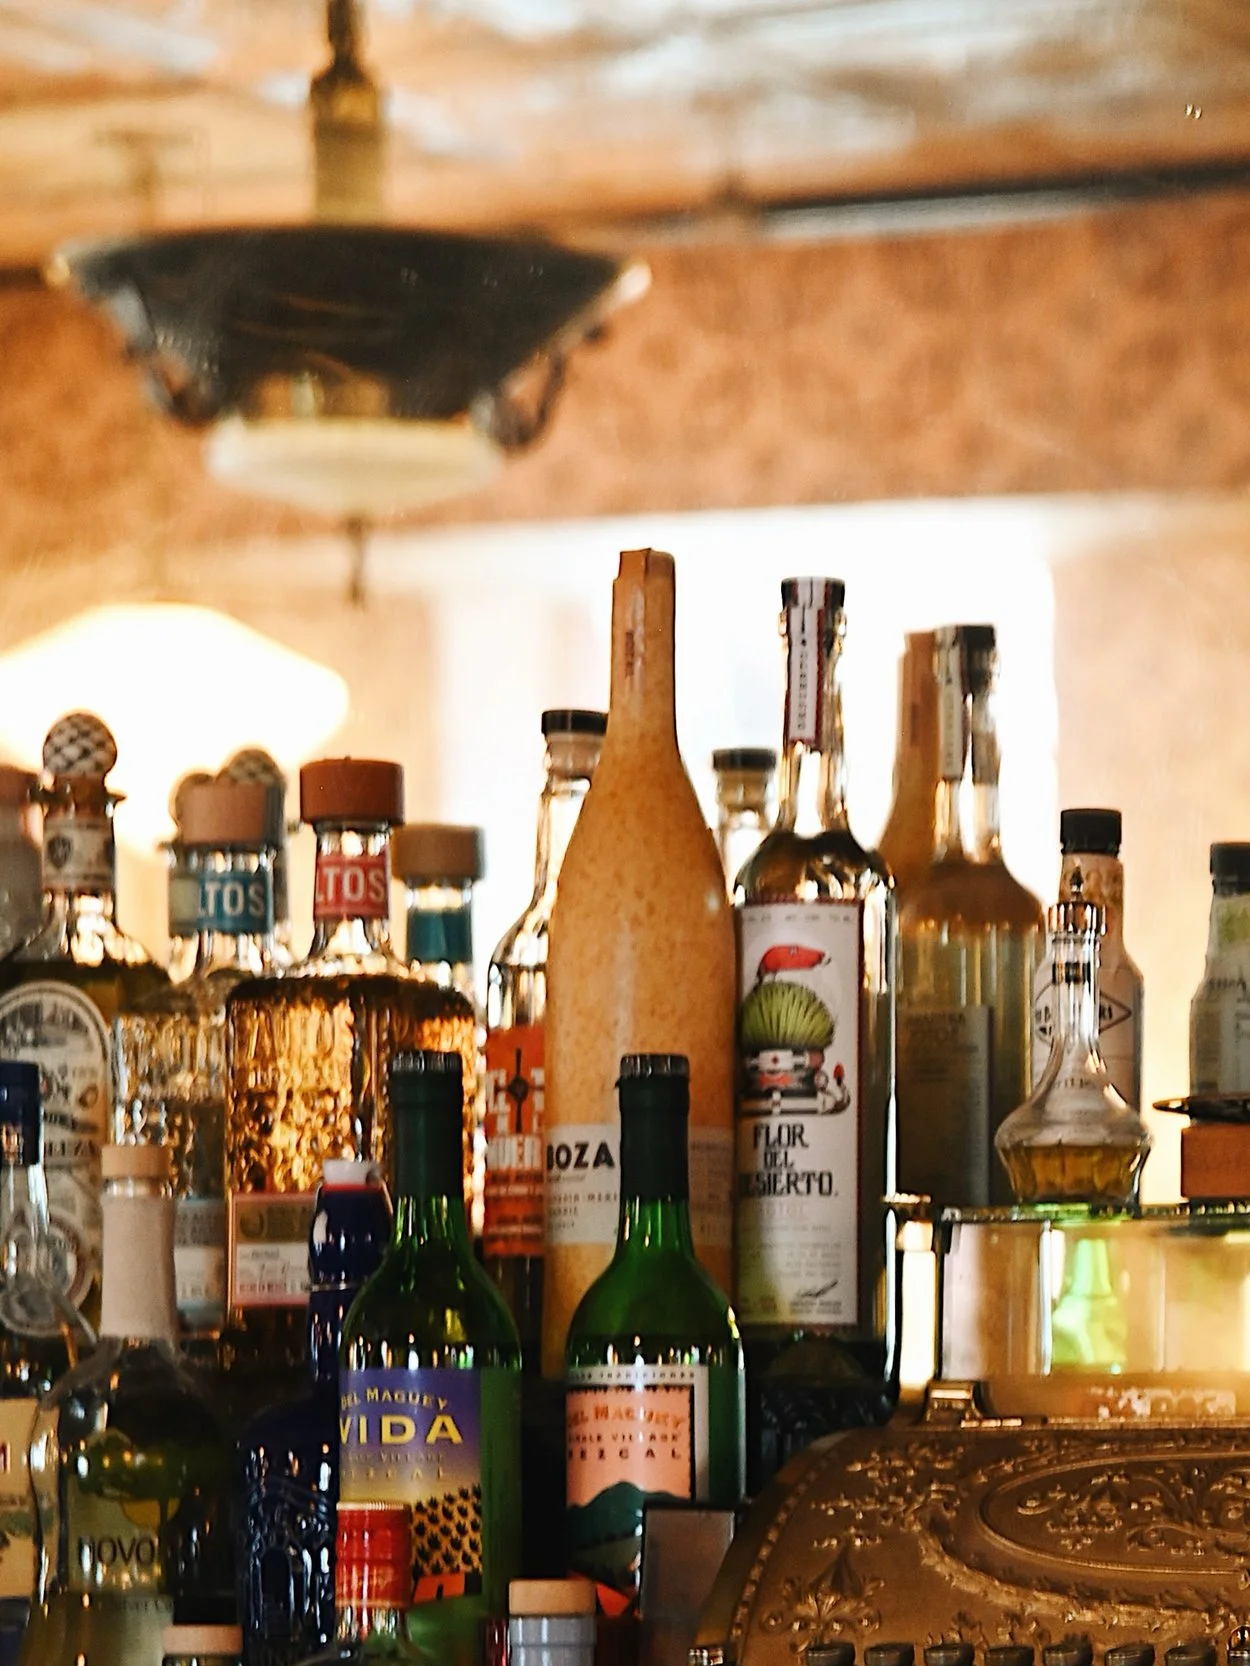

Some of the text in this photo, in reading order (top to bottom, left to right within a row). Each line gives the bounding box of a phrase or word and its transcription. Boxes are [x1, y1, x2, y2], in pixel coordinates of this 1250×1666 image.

[753, 1123, 809, 1149] FLOR
[764, 1150, 795, 1169] DEL
[340, 1413, 464, 1445] VIDA
